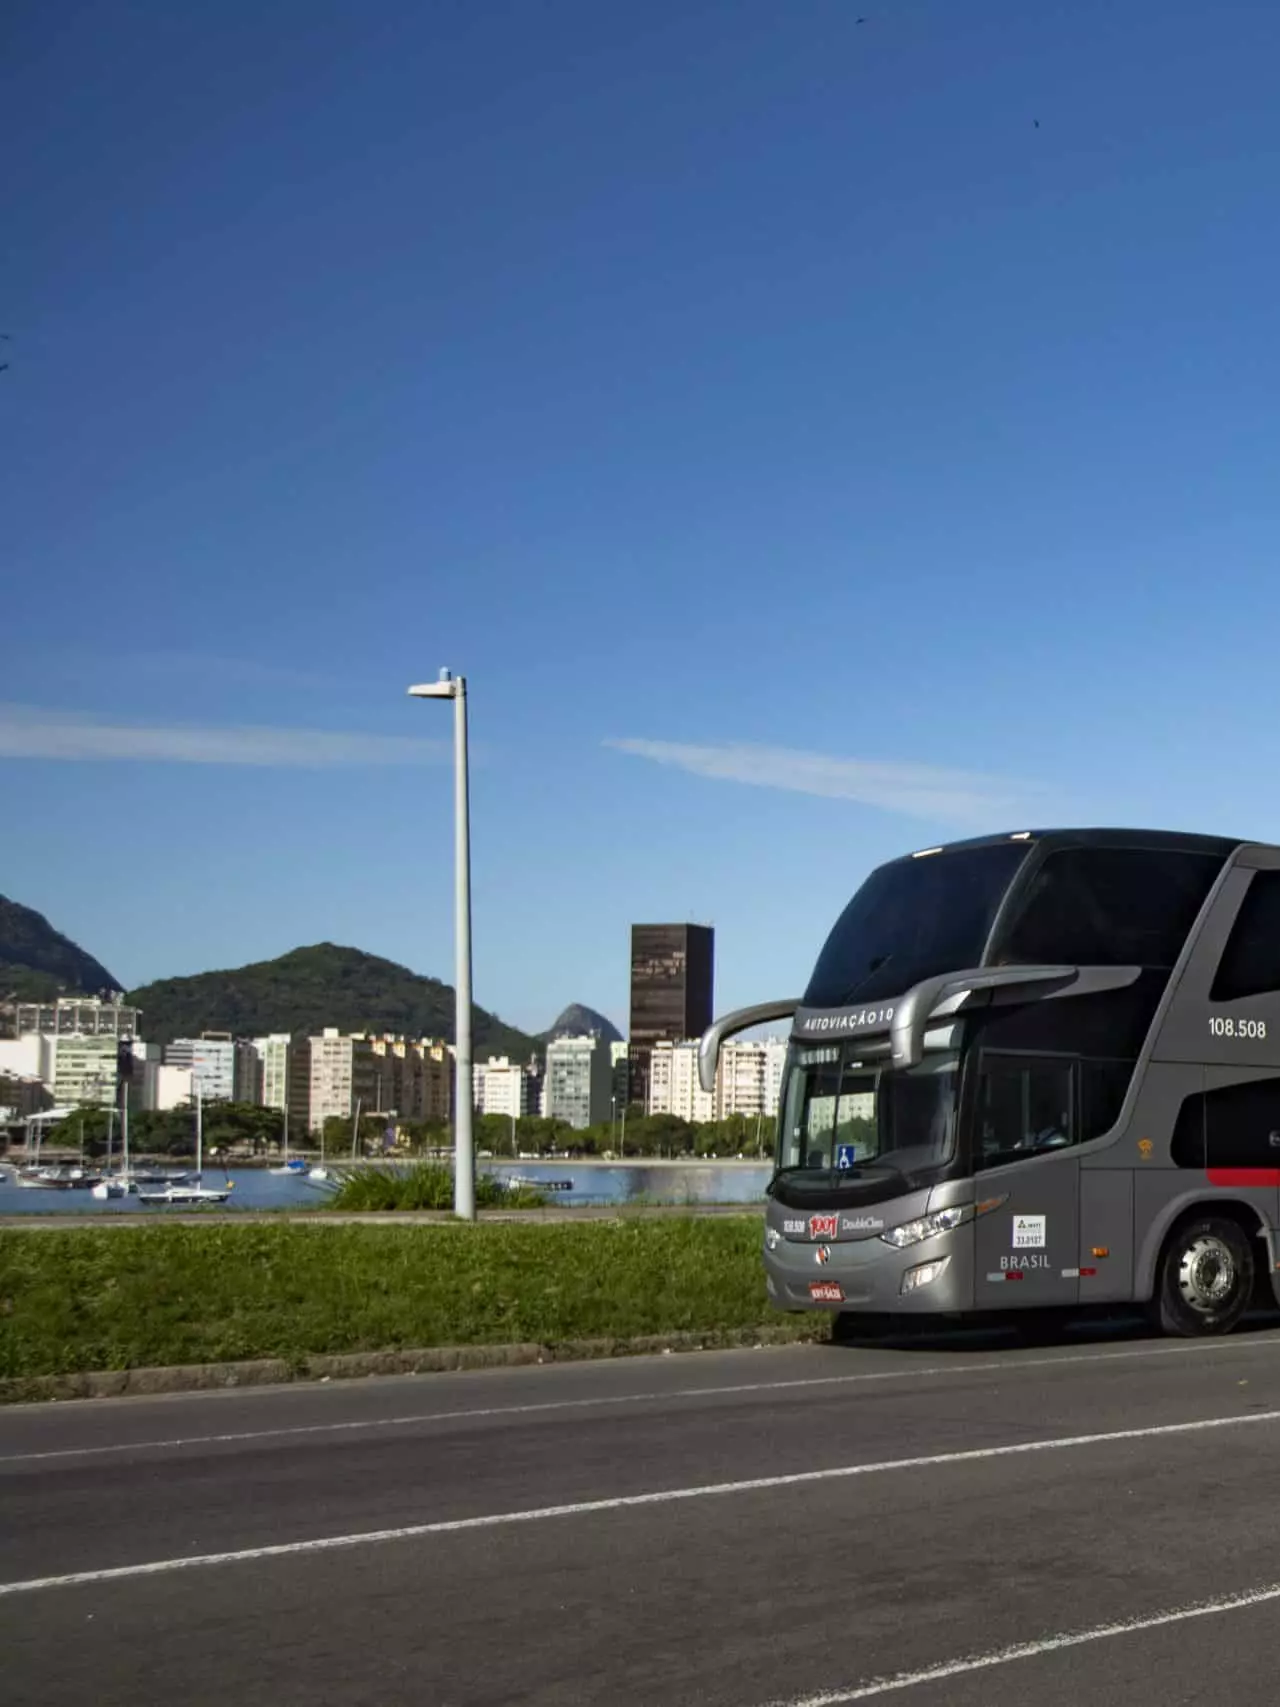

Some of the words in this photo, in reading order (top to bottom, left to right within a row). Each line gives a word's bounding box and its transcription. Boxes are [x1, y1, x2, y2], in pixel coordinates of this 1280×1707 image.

[803, 1007, 894, 1030] AUTOVIAÇÃO10
[1209, 1018, 1266, 1039] 108.508
[1000, 1254, 1051, 1270] BRASIL
